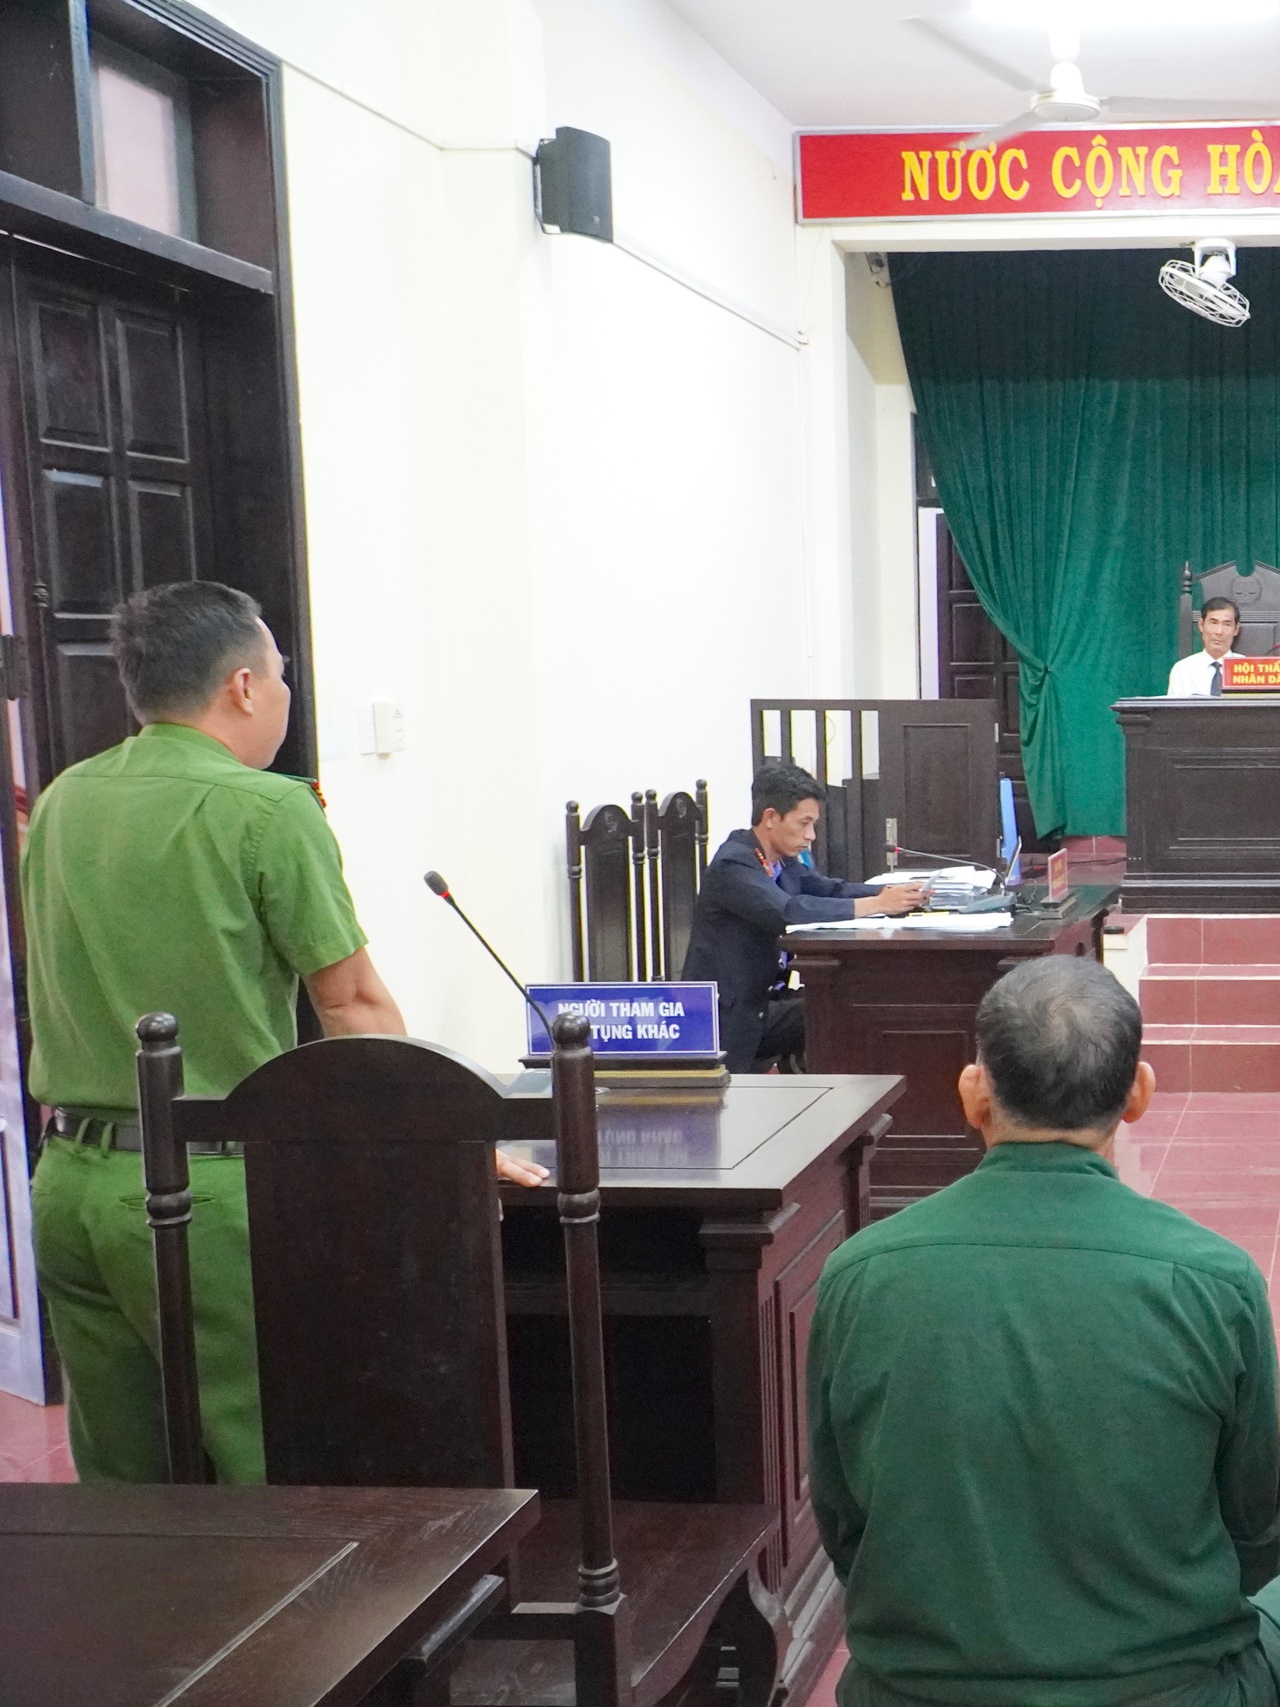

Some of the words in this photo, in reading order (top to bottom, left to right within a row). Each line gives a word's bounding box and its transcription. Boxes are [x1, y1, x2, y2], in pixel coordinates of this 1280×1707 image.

[901, 133, 1030, 201] NƯỚC
[1051, 135, 1183, 207] CỘNG
[1233, 662, 1255, 674] HỘI
[1232, 674, 1265, 684] NHÂN
[557, 999, 606, 1017] NGƯỜI
[609, 1002, 654, 1017] THAM
[658, 1002, 685, 1017] GIA
[591, 1024, 633, 1043] TỤNG
[636, 1021, 680, 1039] KHÁC
